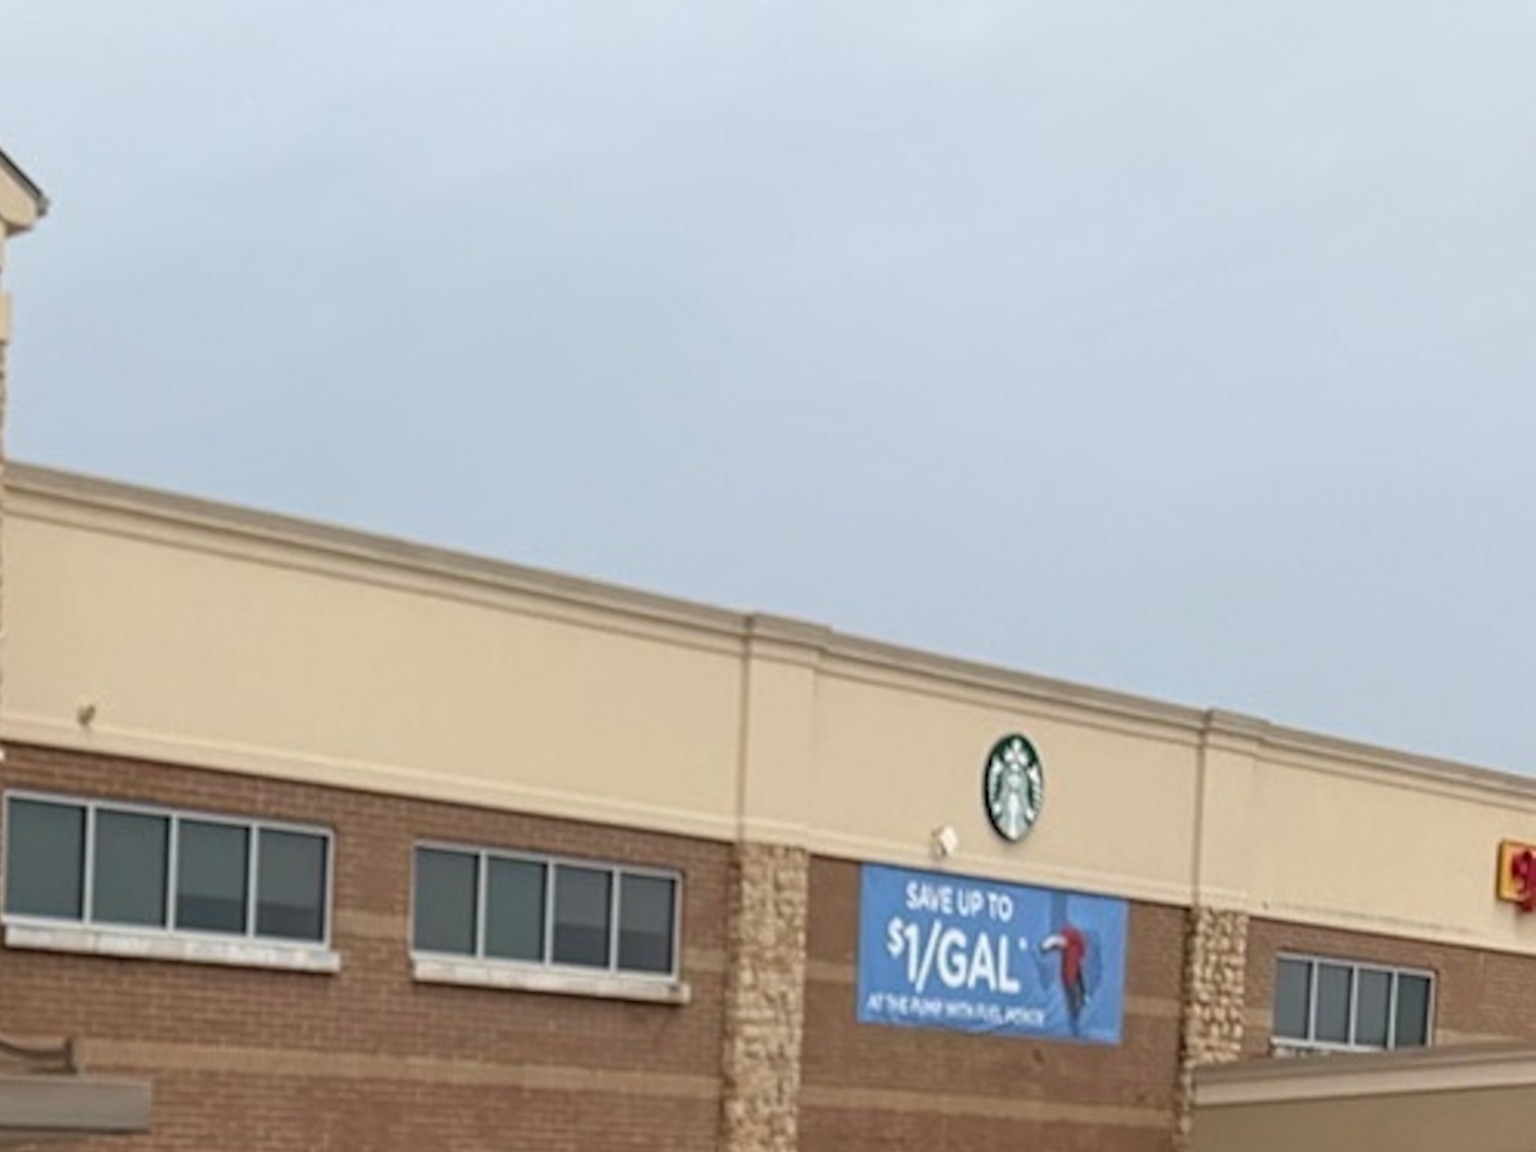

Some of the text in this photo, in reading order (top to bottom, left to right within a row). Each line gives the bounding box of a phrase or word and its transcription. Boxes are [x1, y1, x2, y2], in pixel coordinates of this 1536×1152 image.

[906, 882, 1013, 922] SAVE UP TO
